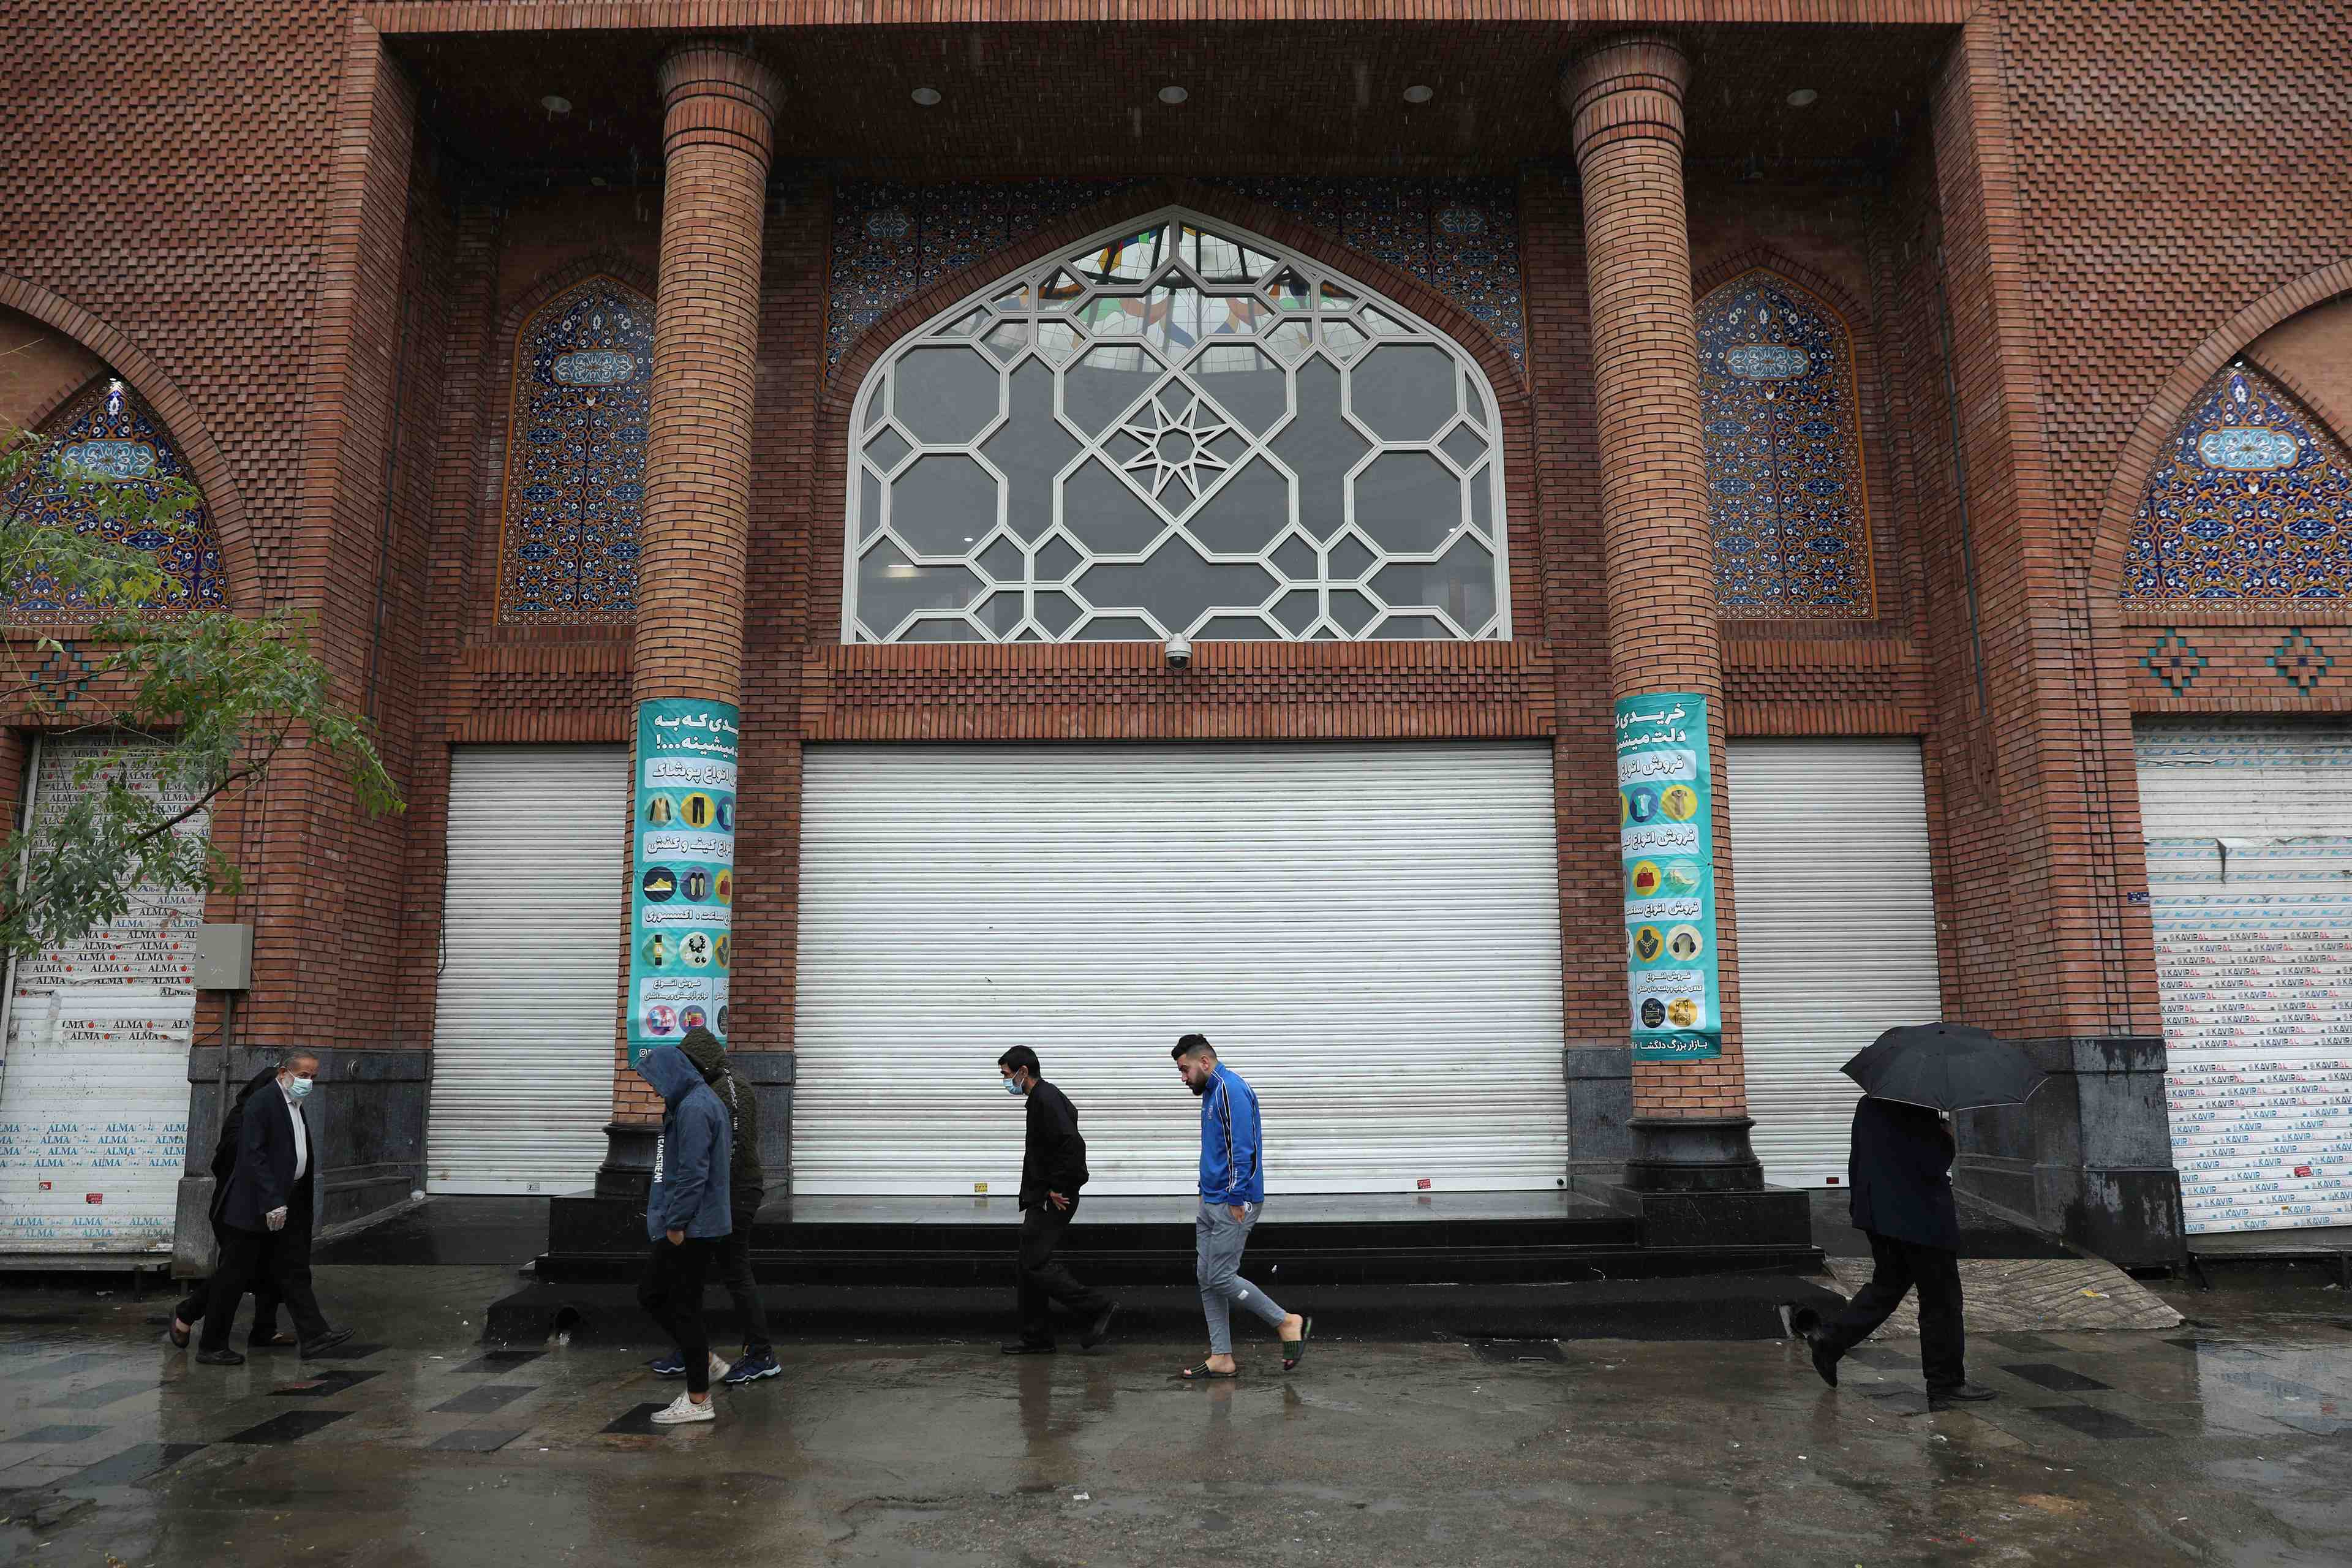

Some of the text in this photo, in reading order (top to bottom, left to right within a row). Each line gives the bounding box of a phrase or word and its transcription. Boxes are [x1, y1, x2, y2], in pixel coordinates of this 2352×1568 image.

[655, 715, 680, 731] به
[682, 714, 707, 726] که
[1621, 703, 1685, 729] خریدی
[1651, 728, 1686, 742] دلت
[652, 762, 701, 783] پوشاک
[1643, 756, 1684, 775] فروش
[703, 766, 729, 784] انواع
[1632, 832, 1655, 850] انواع
[1657, 829, 1694, 846] فروش
[647, 837, 680, 854] کفش
[681, 841, 688, 853] و
[690, 837, 716, 854] کیف
[1644, 903, 1665, 918] انواع
[1668, 902, 1698, 915] فروش
[654, 979, 701, 989] فروش انواع
[1646, 972, 1691, 982] فروش انواع
[113, 1020, 142, 1029] ALMA
[129, 1031, 158, 1040] ALMA
[1640, 1040, 1665, 1049] دلگشا
[1667, 1039, 1686, 1051] بزرگ
[1688, 1039, 1707, 1050] بازار
